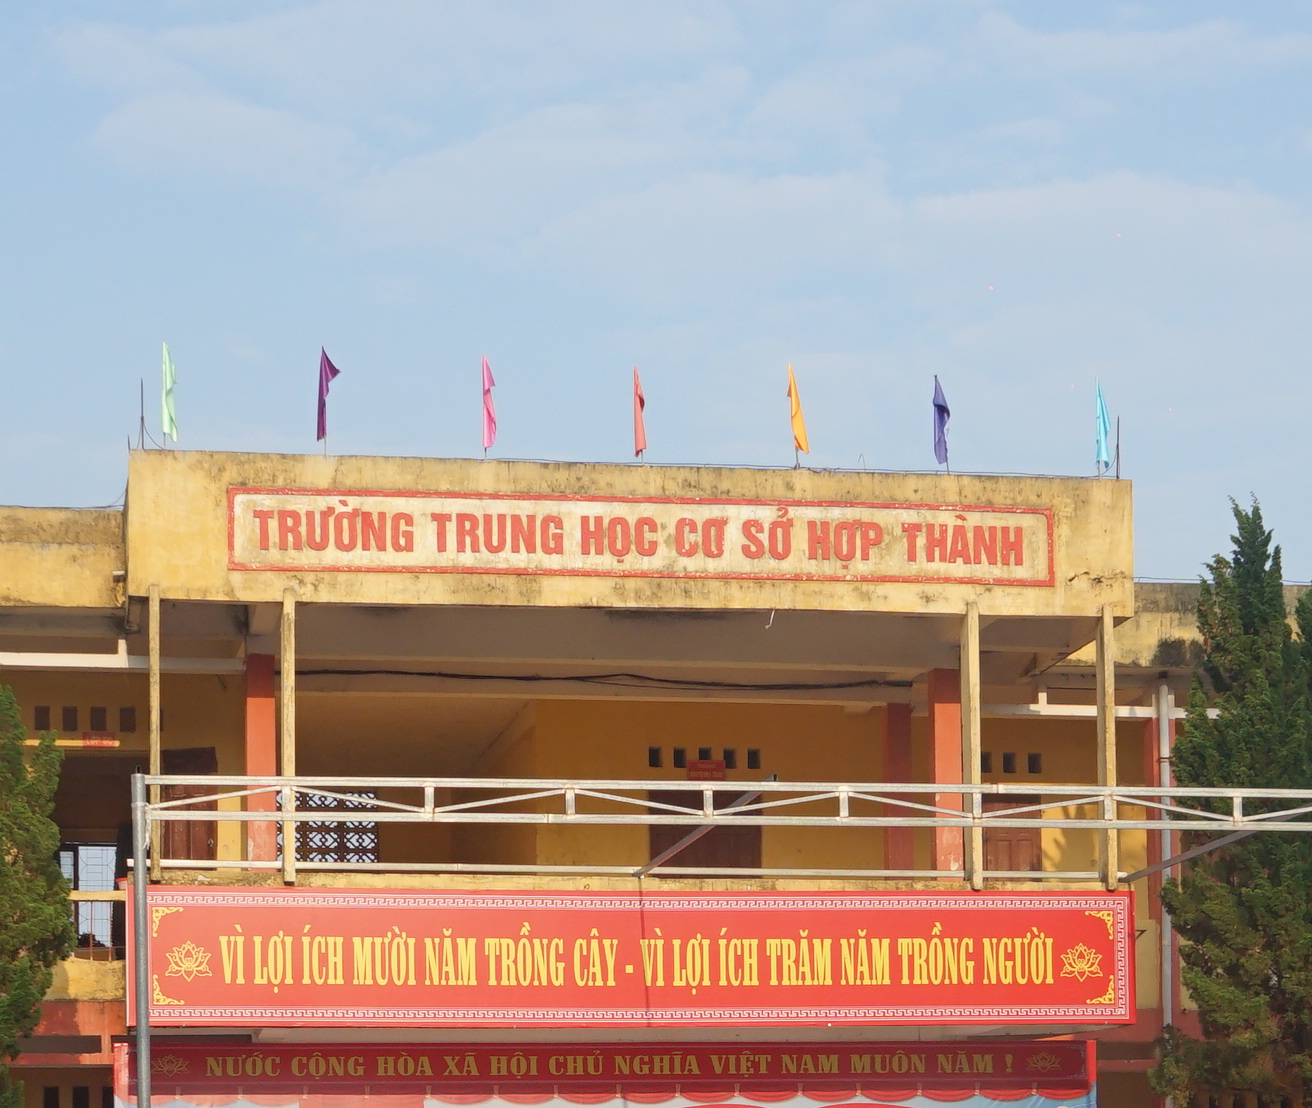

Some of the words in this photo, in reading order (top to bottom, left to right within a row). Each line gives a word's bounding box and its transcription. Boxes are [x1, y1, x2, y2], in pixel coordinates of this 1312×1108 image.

[253, 500, 414, 552] TRƯỜNG
[431, 512, 564, 555] TRUNG
[580, 515, 657, 563] HỌC
[675, 517, 728, 558] CƠ
[741, 507, 793, 560] SỞ
[807, 520, 882, 569] HỢP
[901, 514, 1024, 566] THÀNH
[219, 925, 245, 984] VÌ
[253, 930, 293, 994] LỢI
[301, 925, 345, 985] ÍCH
[352, 925, 417, 985] MƯỜI
[424, 928, 477, 986] NĂM
[485, 922, 565, 986] TRỒNG
[573, 928, 618, 986] CÂY
[640, 928, 665, 986] VÌ
[672, 933, 711, 995] LỢI
[718, 928, 760, 986] ÍCH
[766, 929, 833, 985] TRĂM
[840, 929, 891, 985] NĂM
[898, 922, 974, 985] TRỒNG
[983, 926, 1054, 985] NGƯỜI
[205, 1053, 281, 1077] NƯỚC
[291, 1053, 366, 1080] CỘNG
[376, 1051, 434, 1076] HÒA
[443, 1053, 480, 1076] XÃ
[489, 1051, 538, 1079] HỘI
[548, 1050, 604, 1076] CHỦ
[613, 1051, 701, 1075] NGHĨA
[709, 1051, 771, 1078] VIỆT
[780, 1054, 840, 1074] NAM
[849, 1050, 927, 1074] MUÔN
[936, 1050, 994, 1073] NĂM
